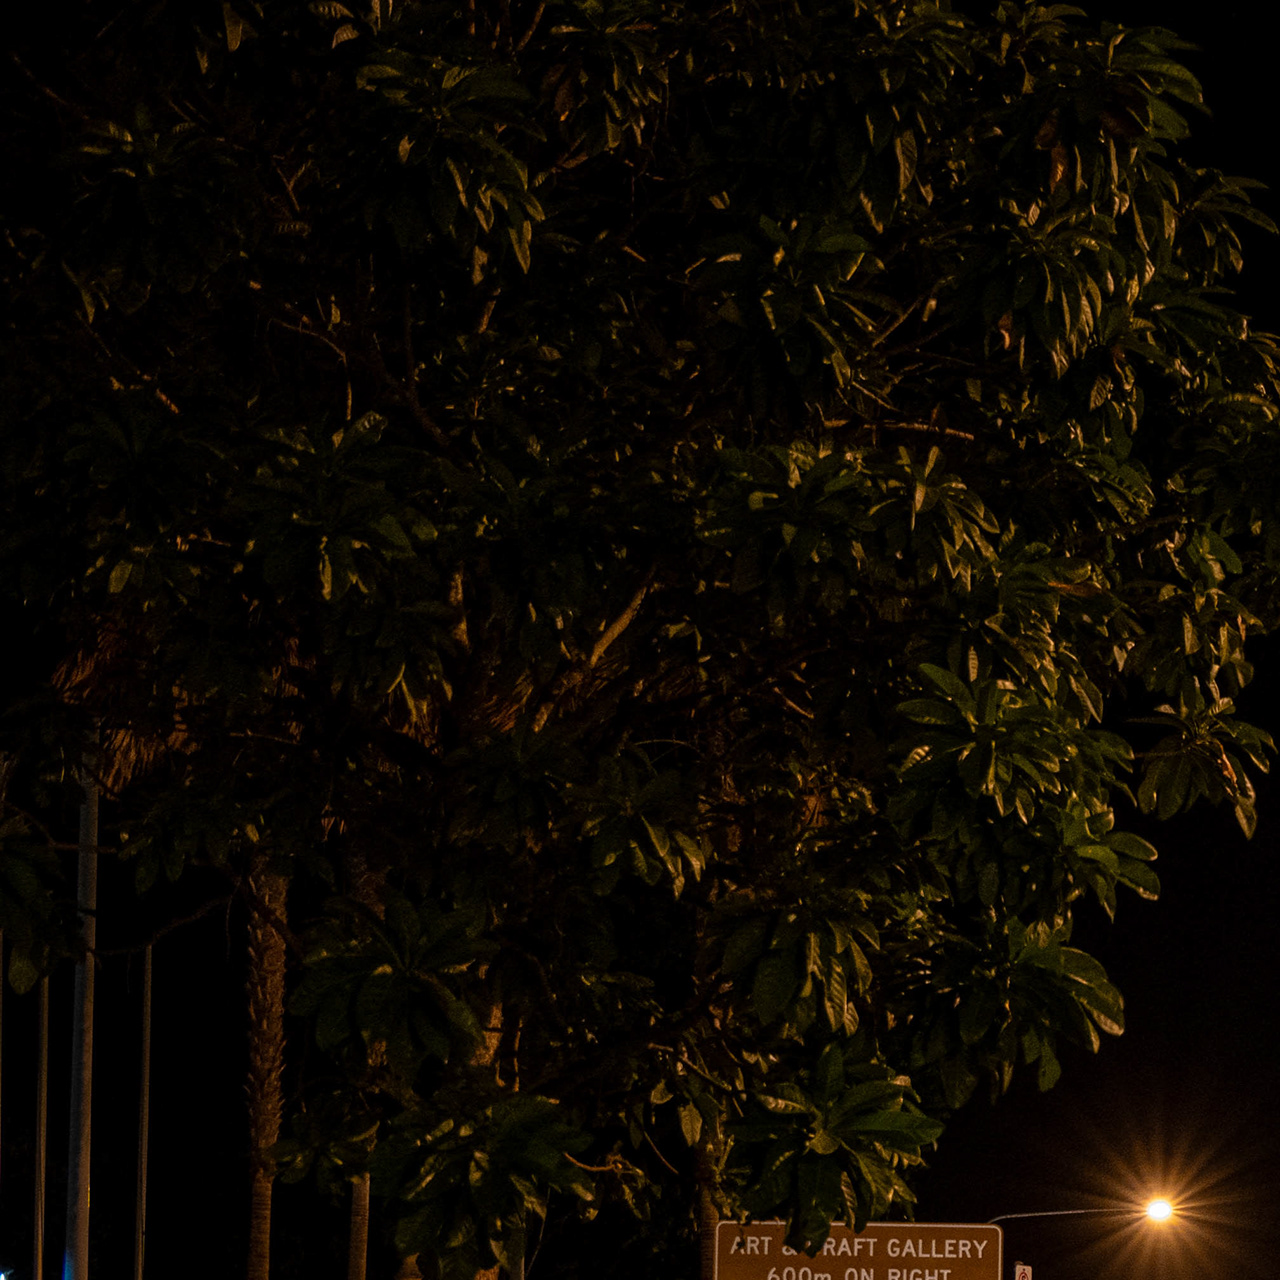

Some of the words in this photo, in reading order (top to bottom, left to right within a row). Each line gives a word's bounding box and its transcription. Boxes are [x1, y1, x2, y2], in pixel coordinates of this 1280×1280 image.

[730, 1236, 772, 1255] ART
[822, 1238, 878, 1257] RAFT
[887, 1238, 988, 1259] GALLERY
